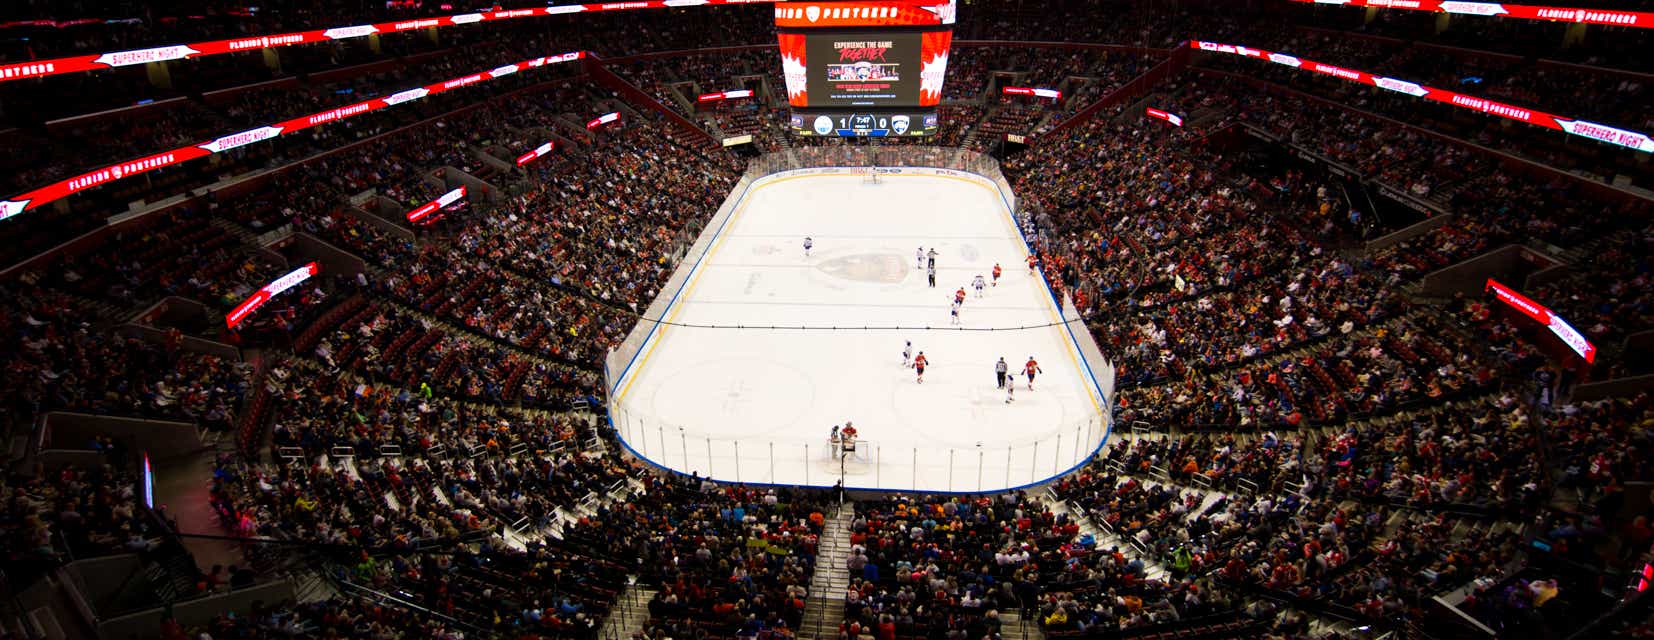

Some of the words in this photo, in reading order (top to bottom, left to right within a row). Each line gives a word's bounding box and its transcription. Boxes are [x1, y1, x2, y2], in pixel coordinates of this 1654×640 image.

[823, 7, 898, 19] PANTHERS
[1537, 9, 1575, 19] FLORIDA
[1585, 10, 1637, 24] PANTHERS
[839, 48, 887, 62] TOGETHER
[1490, 103, 1530, 120] PANTHERS
[840, 118, 846, 128] 1
[879, 118, 887, 128] 0
[1572, 122, 1617, 142] SUPERHERO
[1618, 132, 1645, 149] NIGHT
[69, 170, 110, 191] FLORIDA
[123, 153, 175, 174] PANTHERS
